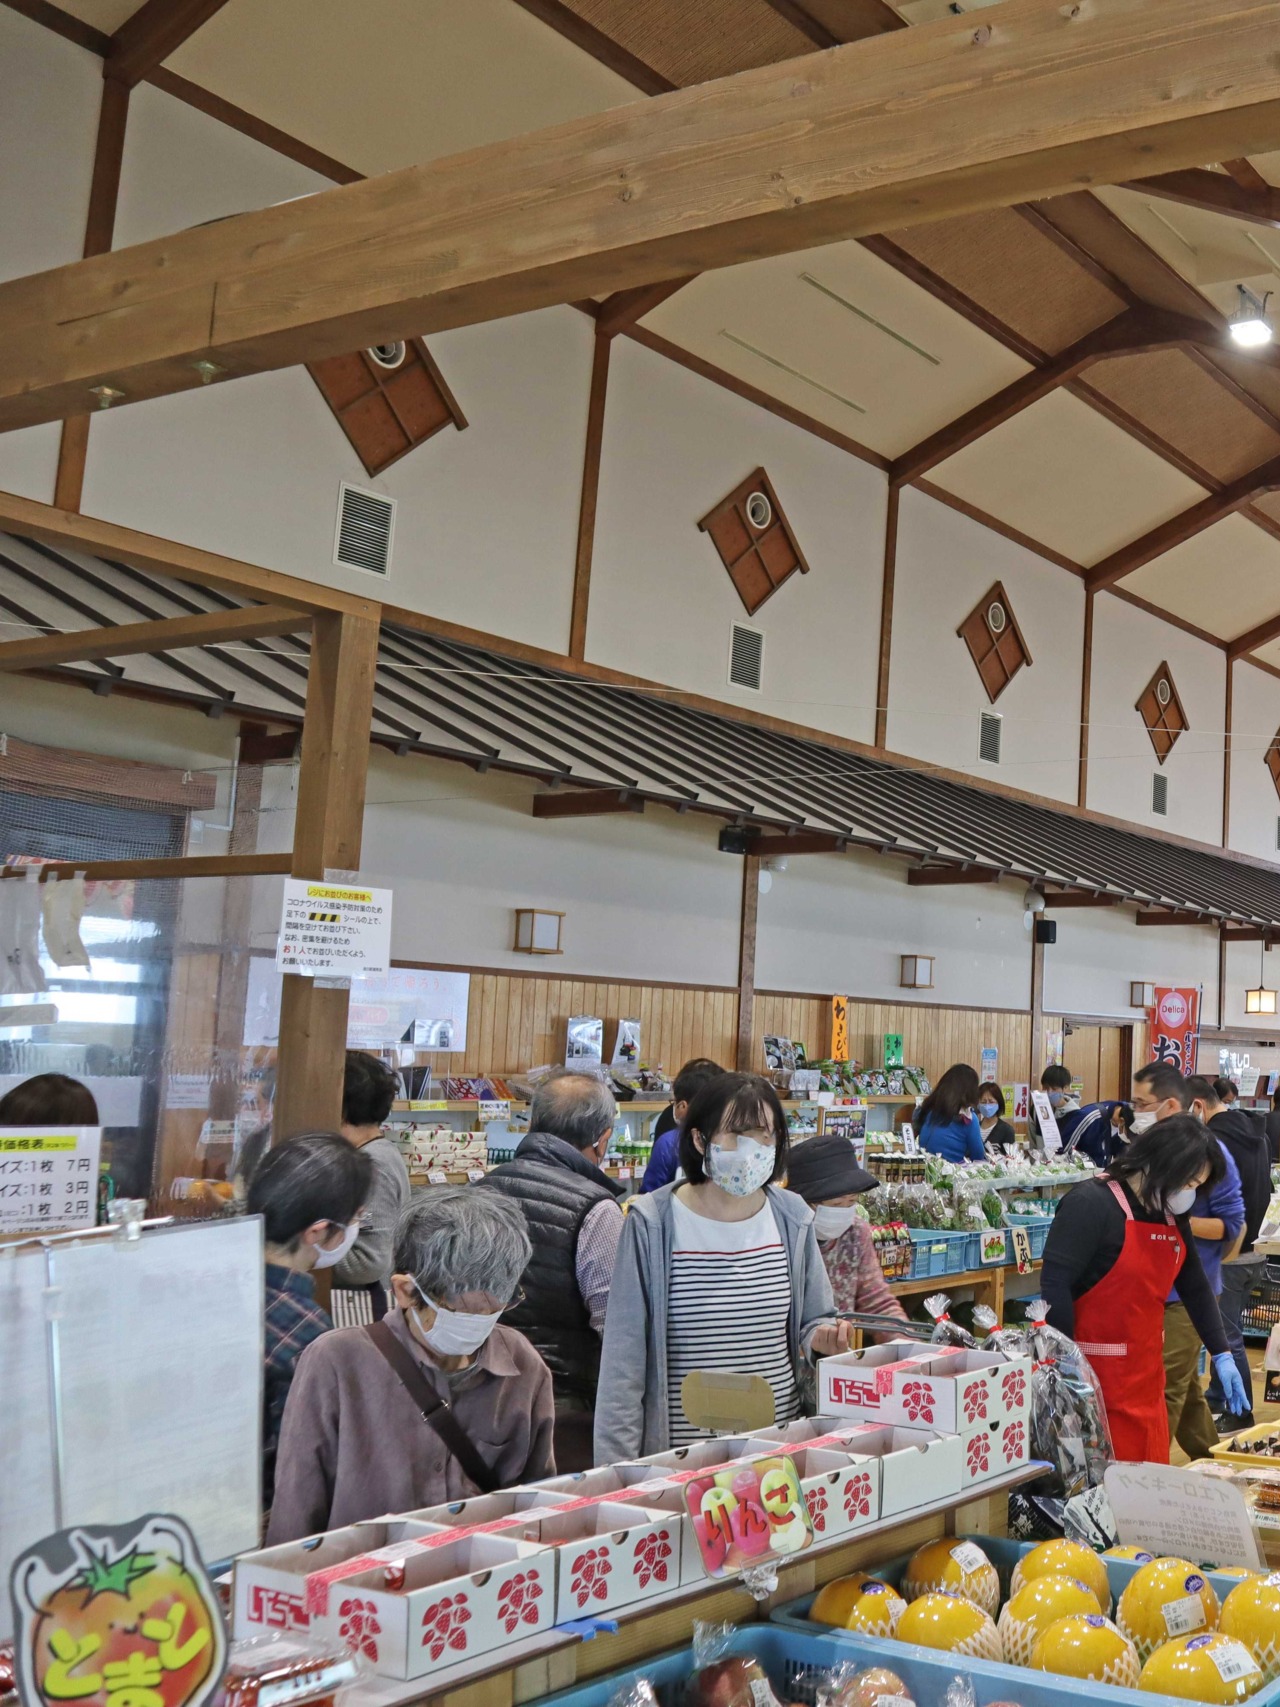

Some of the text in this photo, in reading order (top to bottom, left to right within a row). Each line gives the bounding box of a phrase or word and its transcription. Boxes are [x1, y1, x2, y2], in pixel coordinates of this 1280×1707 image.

[307, 888, 372, 901] レジにお並びのお客様へ
[287, 899, 383, 914] コロナウイルス感染予防対策のため
[286, 909, 307, 918] 足下の
[285, 922, 361, 934] 間隔を空けてお並び下さい。
[282, 957, 334, 967] お願いいたします。
[1161, 1004, 1185, 1014] Delica
[0, 1138, 44, 1150] 価格表
[67, 1158, 90, 1172] 7円
[65, 1180, 89, 1194] 3円
[64, 1200, 89, 1214] 2円
[983, 1235, 1002, 1248] レタス
[1016, 1231, 1030, 1263] かぶ
[885, 1255, 896, 1264] 150
[704, 1483, 797, 1544] りんご
[44, 1602, 211, 1707] とまと
